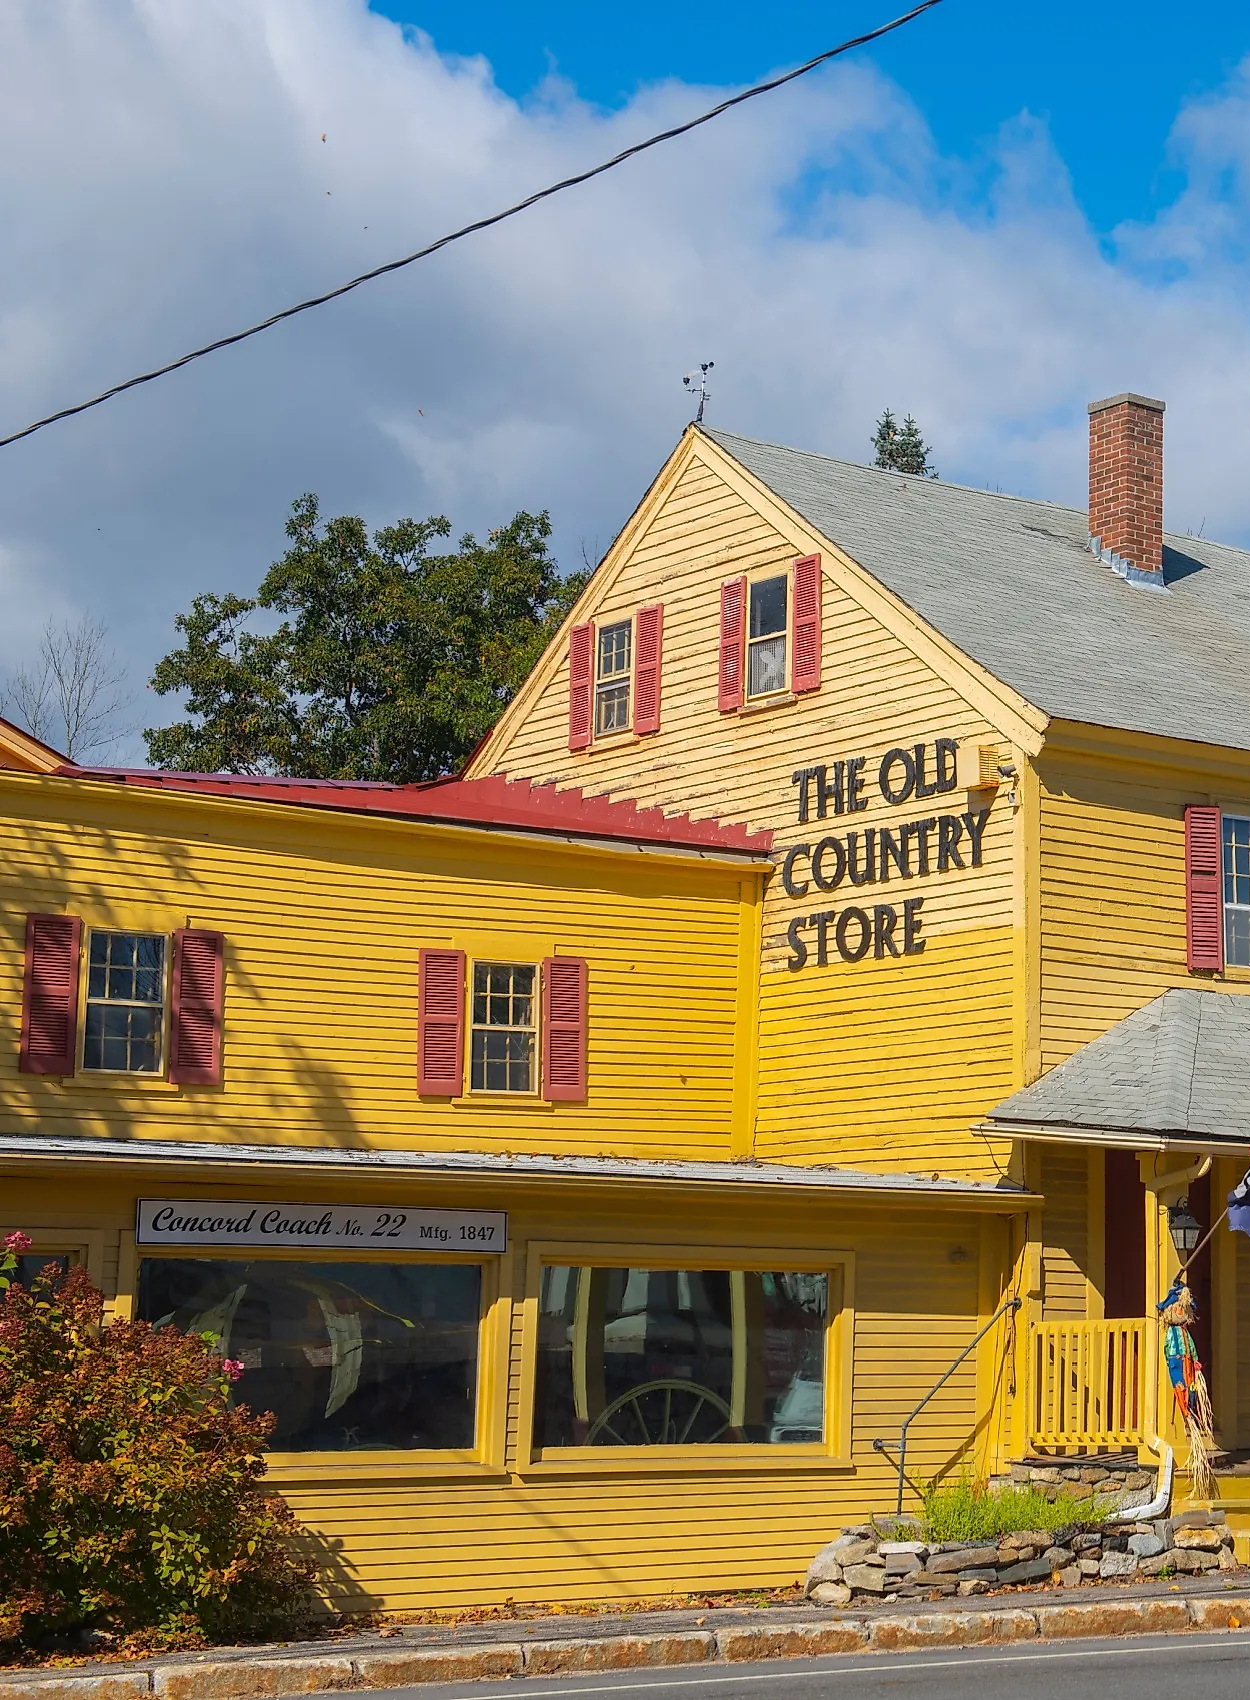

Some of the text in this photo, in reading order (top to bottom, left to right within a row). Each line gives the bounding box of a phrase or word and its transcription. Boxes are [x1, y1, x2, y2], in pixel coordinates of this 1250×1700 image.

[792, 738, 960, 822] THE OLD
[783, 808, 991, 899] COUNTRY
[788, 897, 926, 973] STORE
[152, 1206, 495, 1242] Concord Coach No. 22 Mfg. 1847
